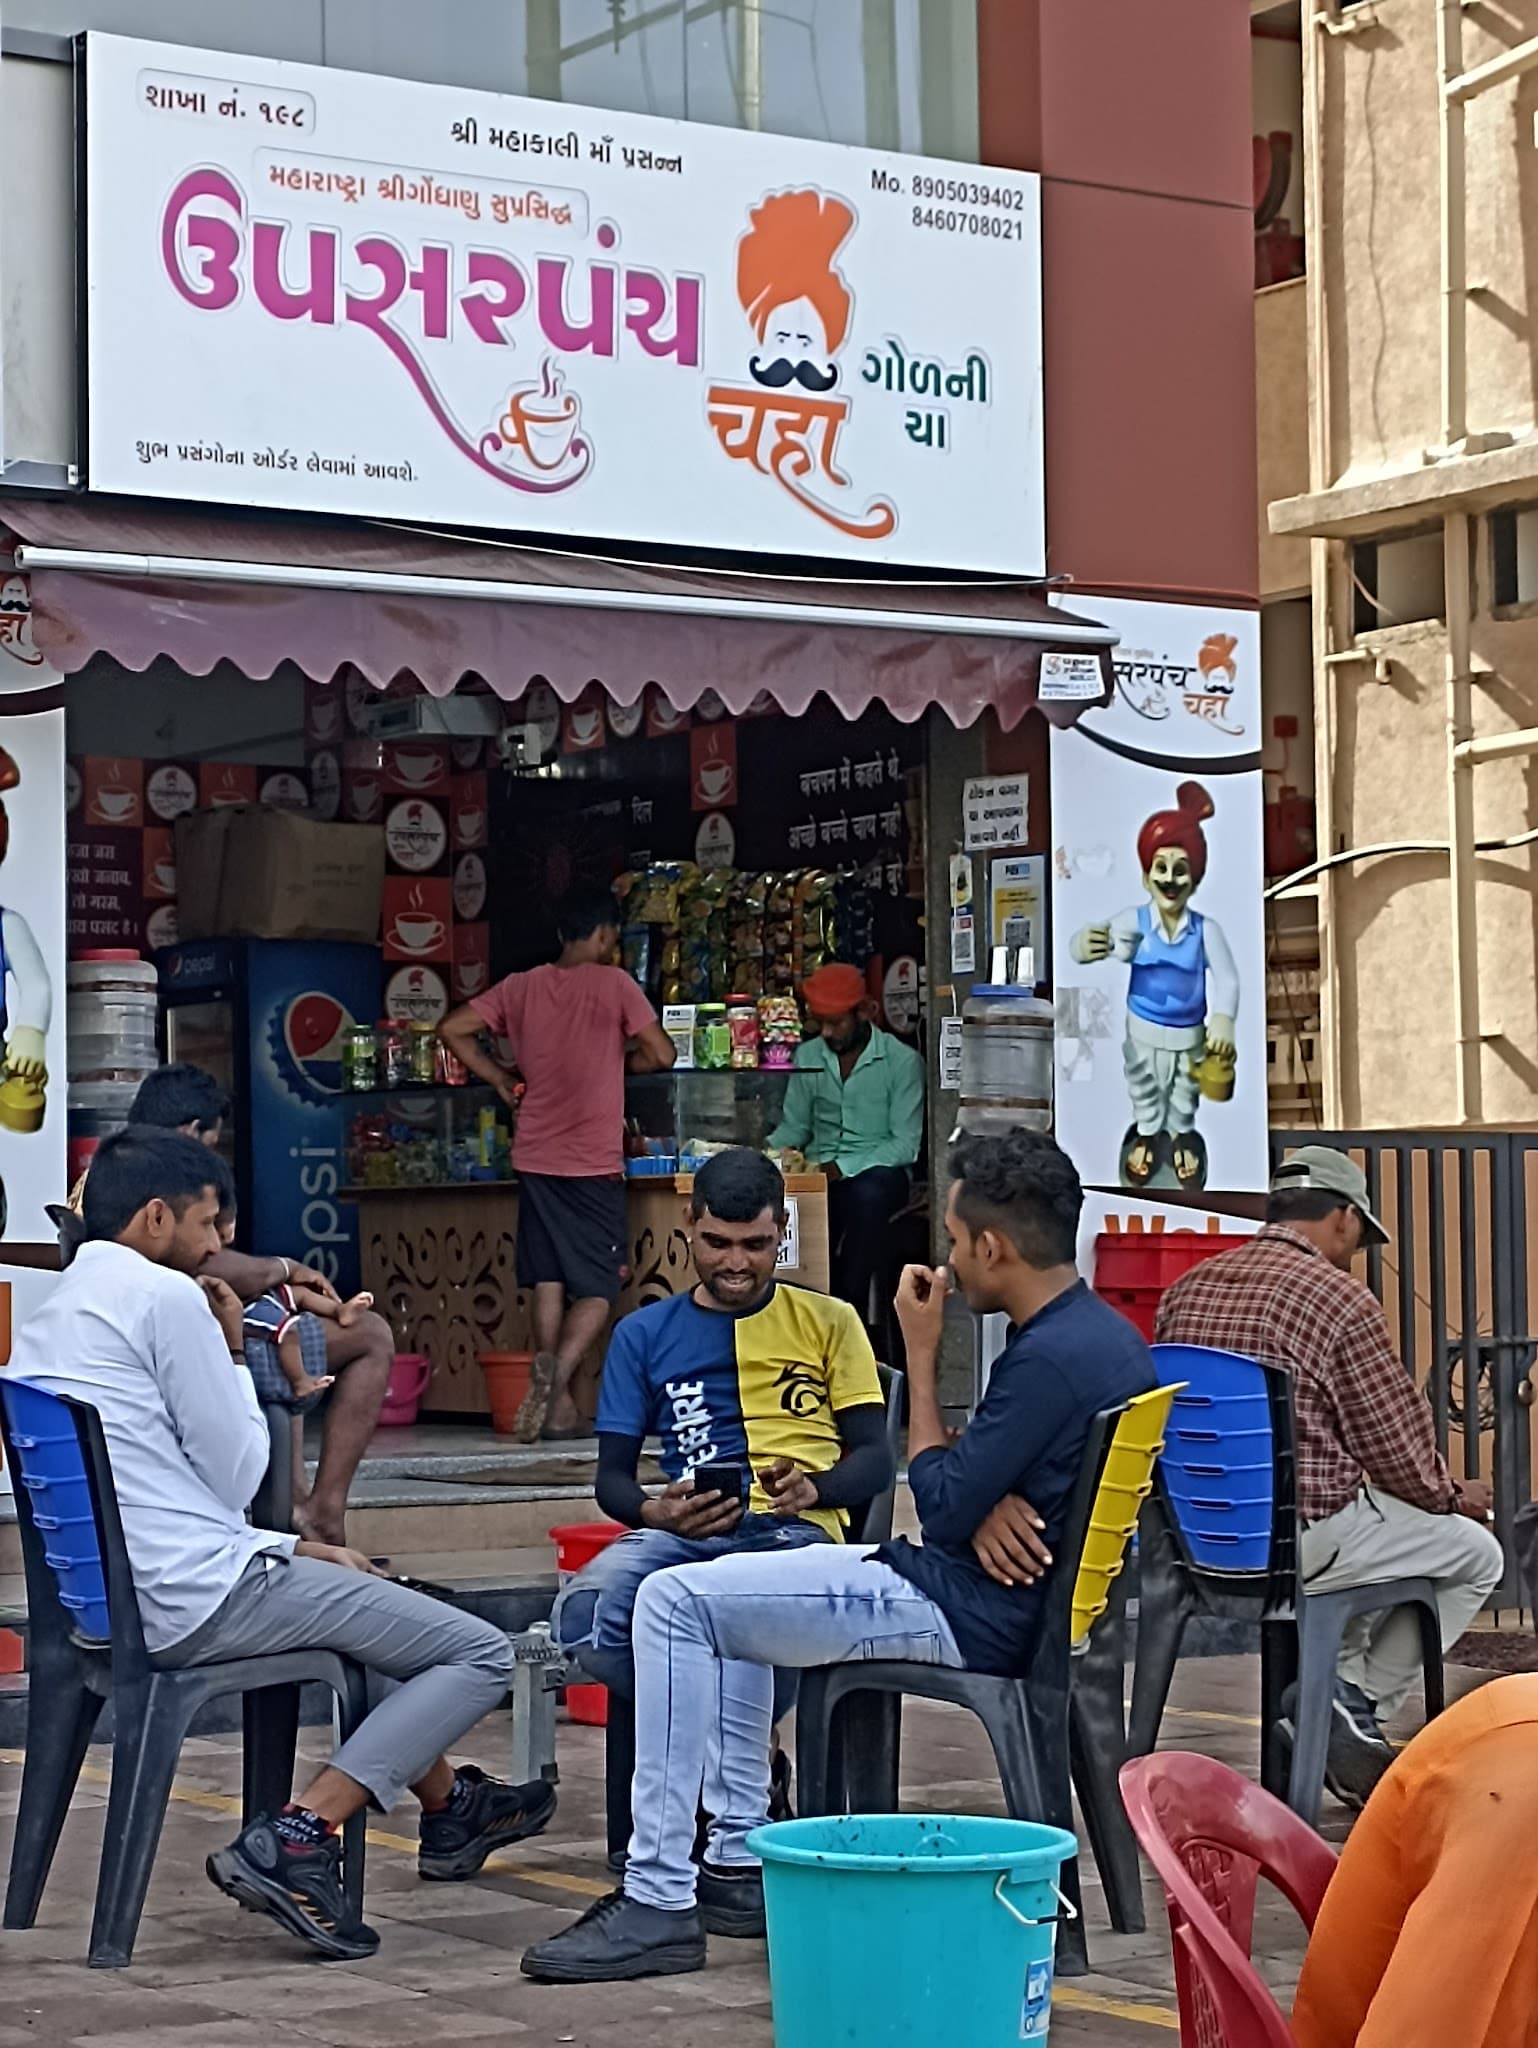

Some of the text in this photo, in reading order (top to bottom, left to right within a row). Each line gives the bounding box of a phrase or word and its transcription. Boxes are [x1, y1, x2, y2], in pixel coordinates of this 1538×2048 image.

[146, 84, 206, 113] શાખા
[259, 102, 305, 127] ૧૯૮
[451, 117, 478, 145] શ્રી
[489, 126, 579, 160] મહાકાલી
[872, 170, 1024, 211] Mo. 8905039402
[912, 205, 1023, 240] 8460708021
[163, 172, 699, 493] ઉપસરપંચ
[861, 340, 987, 403] ગોળની
[904, 411, 945, 449] ચા
[136, 440, 168, 464] શુભ
[177, 442, 244, 465] પ્રસંગોના
[306, 452, 355, 476] લેવામાં
[709, 389, 894, 539] चहा
[289, 1147, 350, 1284] epsi
